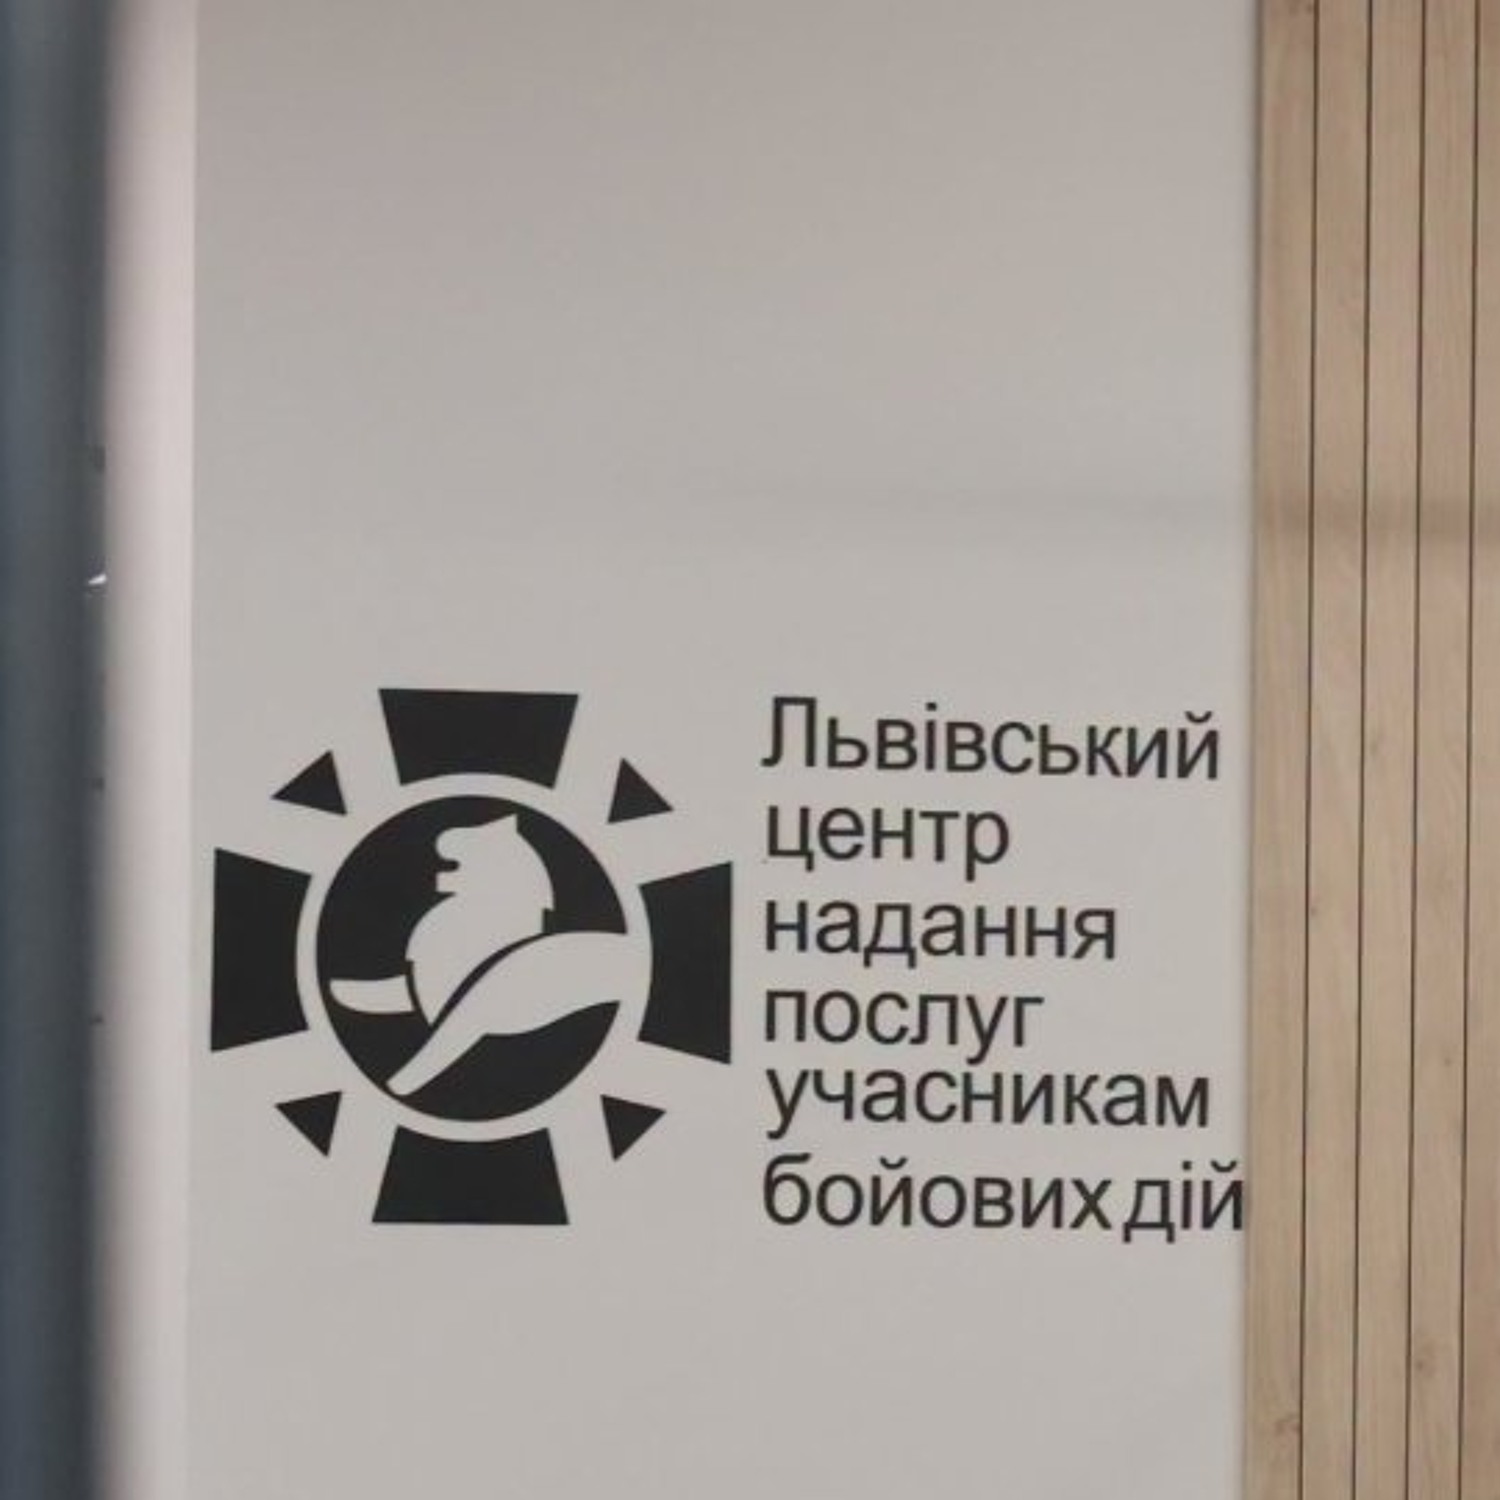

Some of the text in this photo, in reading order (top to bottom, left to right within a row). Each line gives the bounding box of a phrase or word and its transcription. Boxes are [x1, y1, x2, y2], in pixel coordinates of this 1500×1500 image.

[760, 695, 1220, 781] Львівський
[766, 804, 1011, 883] центр
[764, 899, 1117, 970] надання
[764, 989, 1045, 1067] послуг
[764, 1068, 1211, 1141] учасникам
[762, 1151, 1245, 1244] бойових дій
